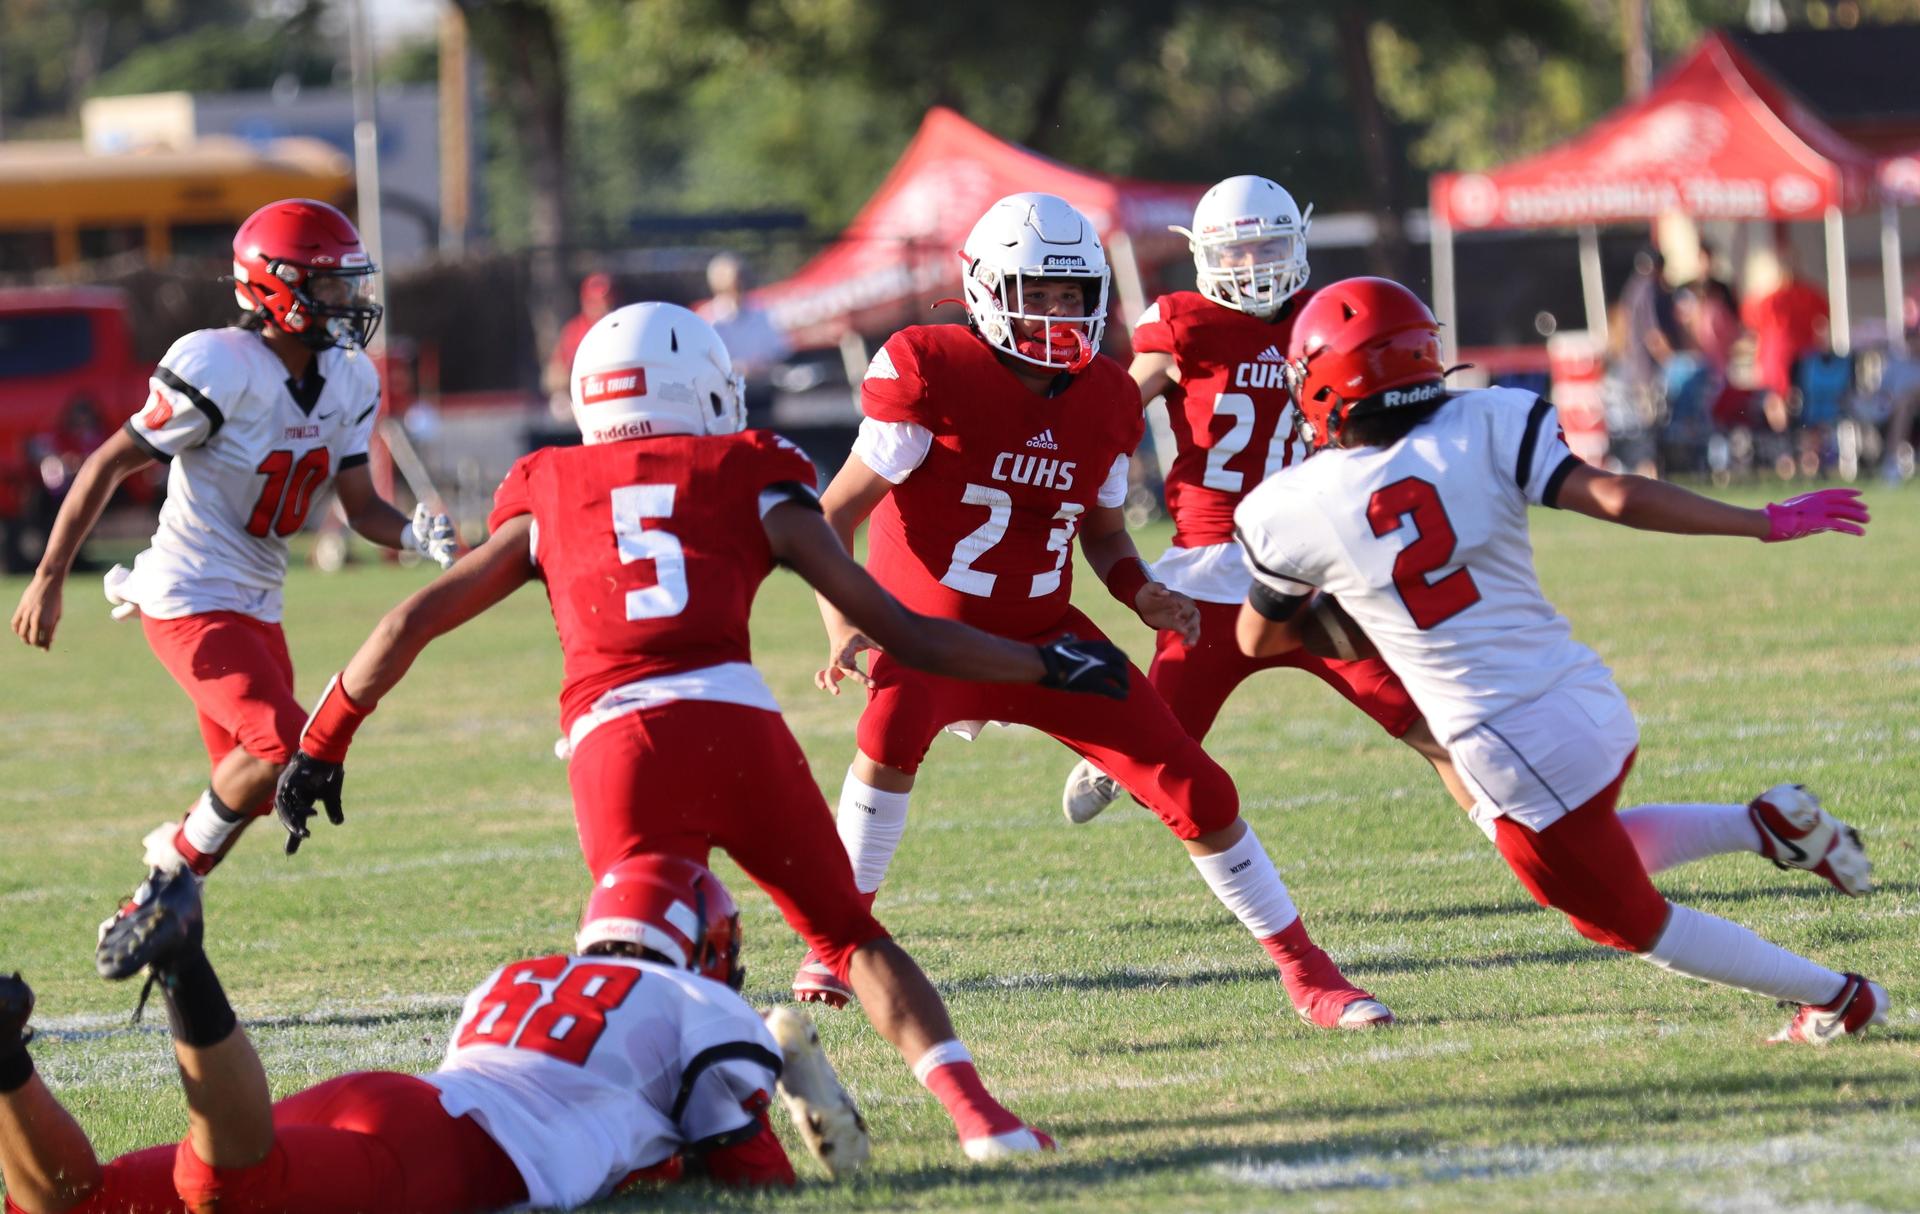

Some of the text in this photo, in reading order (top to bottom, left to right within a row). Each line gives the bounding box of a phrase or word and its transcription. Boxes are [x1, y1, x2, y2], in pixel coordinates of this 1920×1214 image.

[1048, 256, 1083, 266] Riddell
[607, 375, 638, 394] TRIBE
[1235, 362, 1289, 390] CUH
[1026, 440, 1058, 450] adidas
[991, 452, 1077, 491] CUHS
[244, 446, 329, 539] 10
[611, 484, 690, 622] 5
[1366, 475, 1482, 630] 2
[457, 954, 642, 1068] 68
